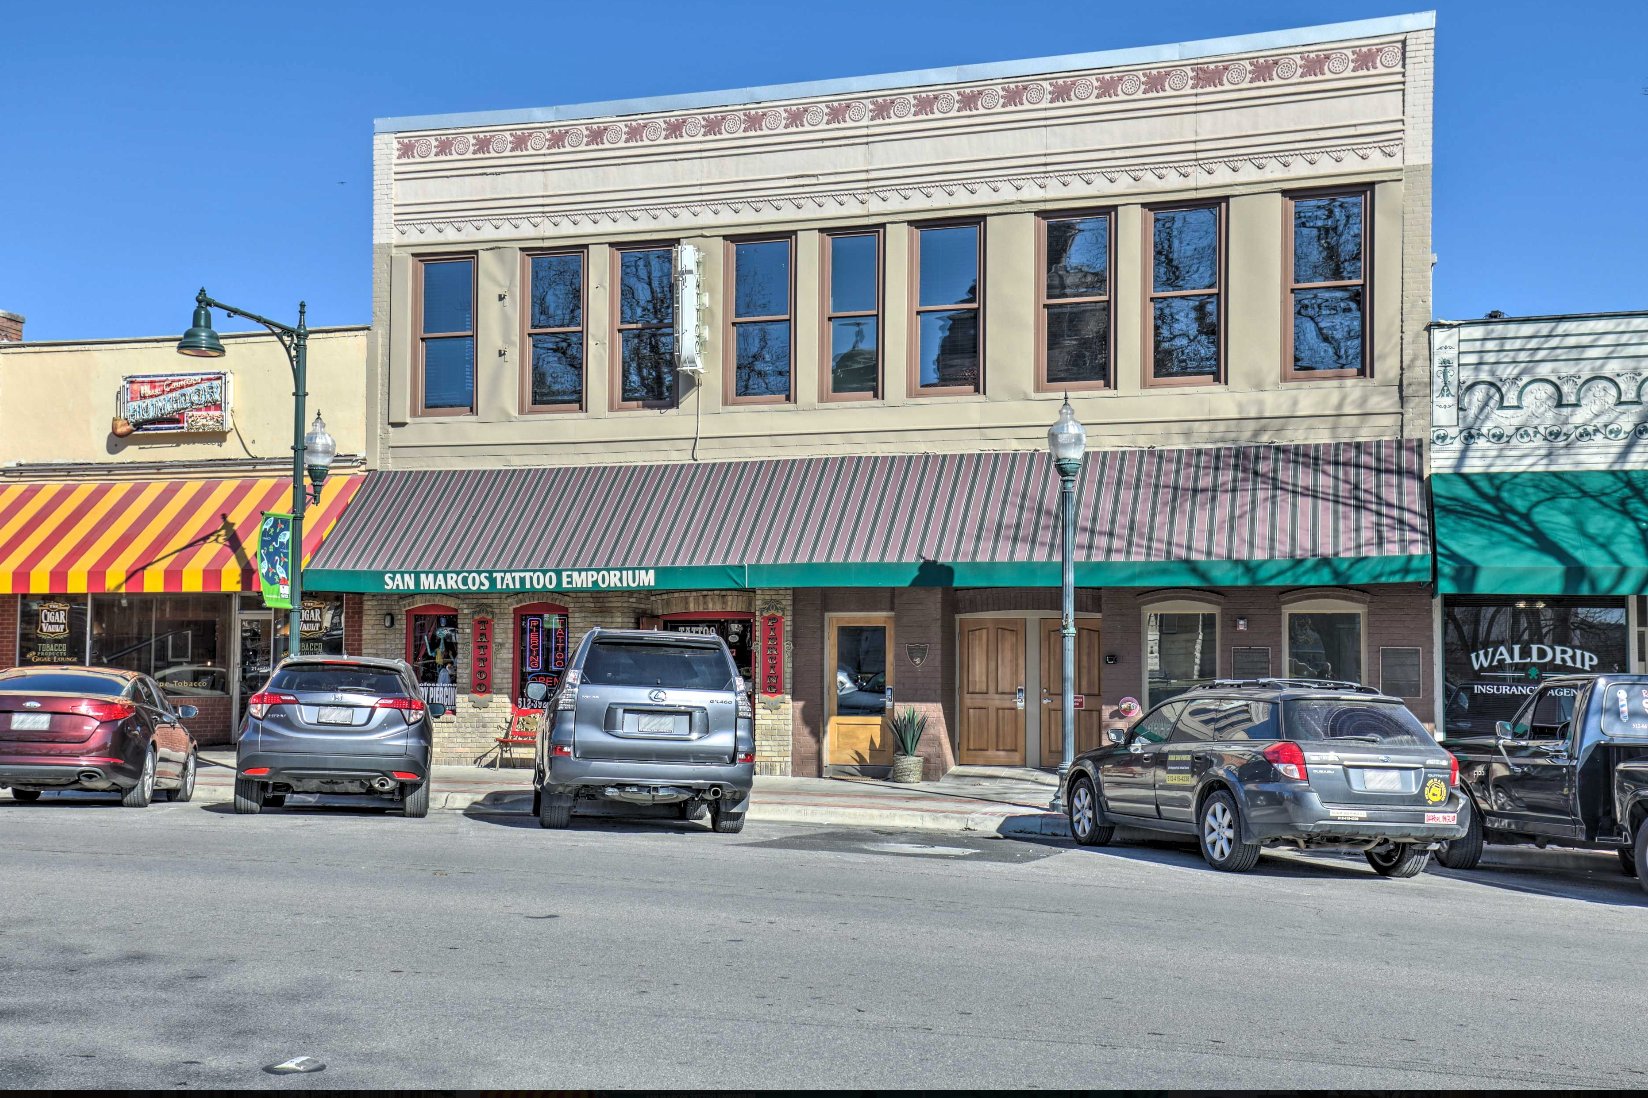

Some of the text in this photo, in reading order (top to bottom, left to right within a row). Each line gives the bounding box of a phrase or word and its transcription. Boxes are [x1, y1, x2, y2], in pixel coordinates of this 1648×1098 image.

[127, 381, 221, 423] HUMIDOR
[384, 569, 655, 590] SAN MARCOS TATTOO EMPORIUM
[41, 609, 66, 623] CIGAR
[300, 608, 322, 622] IGAR
[41, 622, 65, 633] VAULT
[678, 626, 716, 635] TATTOO
[38, 644, 67, 652] TOBACCO
[301, 642, 323, 651] BACCO
[529, 620, 539, 668] PIERCING
[555, 619, 565, 667] TATTOO
[476, 620, 489, 693] TATTOO
[766, 617, 778, 693] PIERCING
[1470, 644, 1599, 671] WALDRIP
[172, 680, 208, 688] Tobacco
[1474, 684, 1578, 697] INSURANC AGEN
[429, 686, 457, 706] PIERCIN
